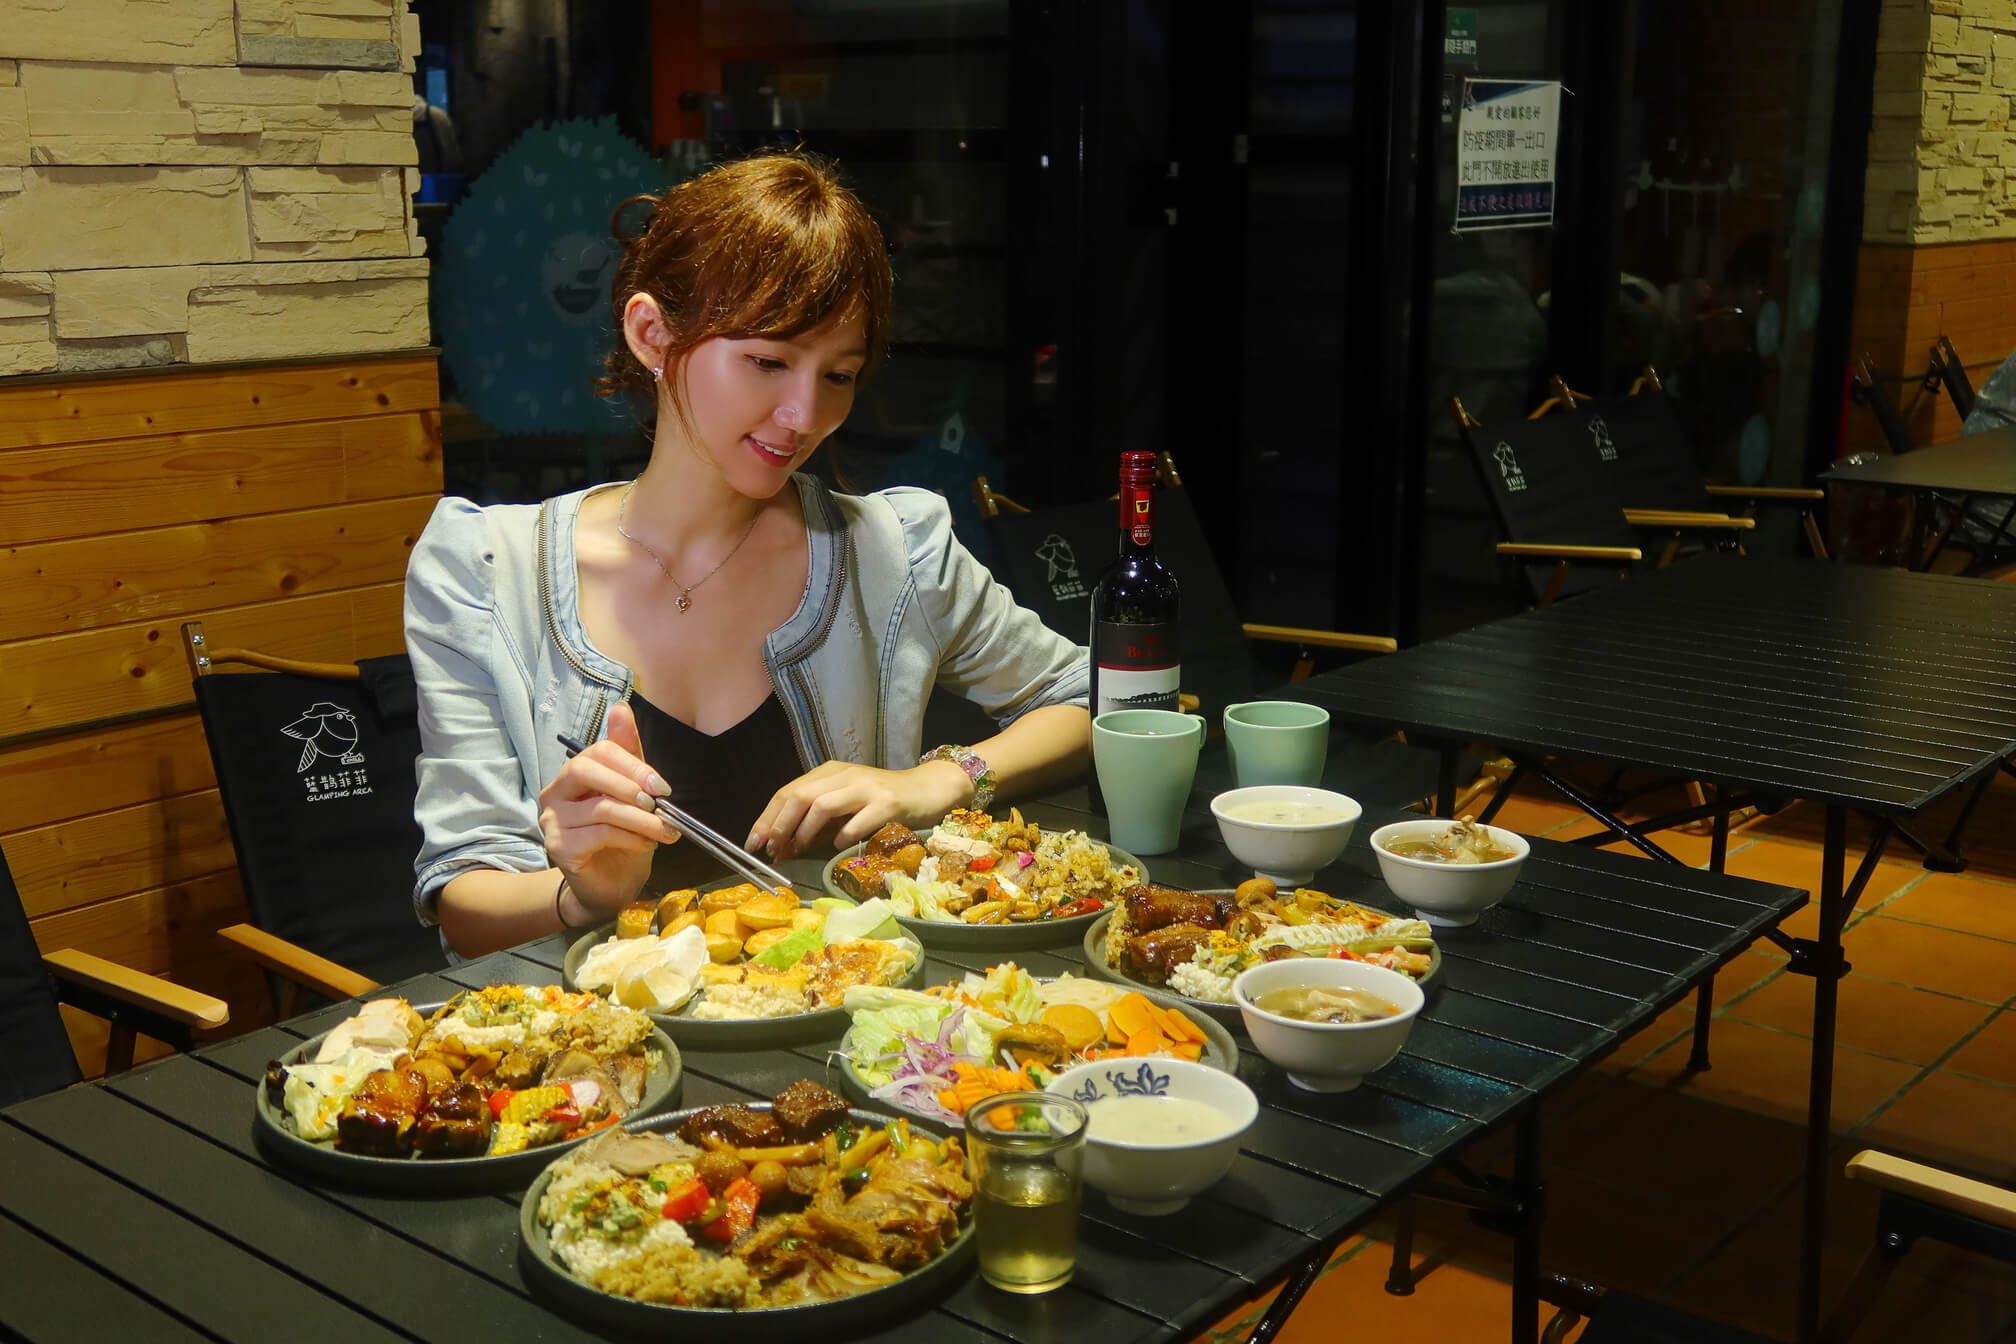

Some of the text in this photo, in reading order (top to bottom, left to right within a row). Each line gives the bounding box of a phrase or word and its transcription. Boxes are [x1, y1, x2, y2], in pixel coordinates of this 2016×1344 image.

[1463, 129, 1546, 151] 防疫期間單一出口
[1462, 160, 1549, 181] 此門不開放進出使用
[306, 786, 373, 802] GLAMPING AREA
